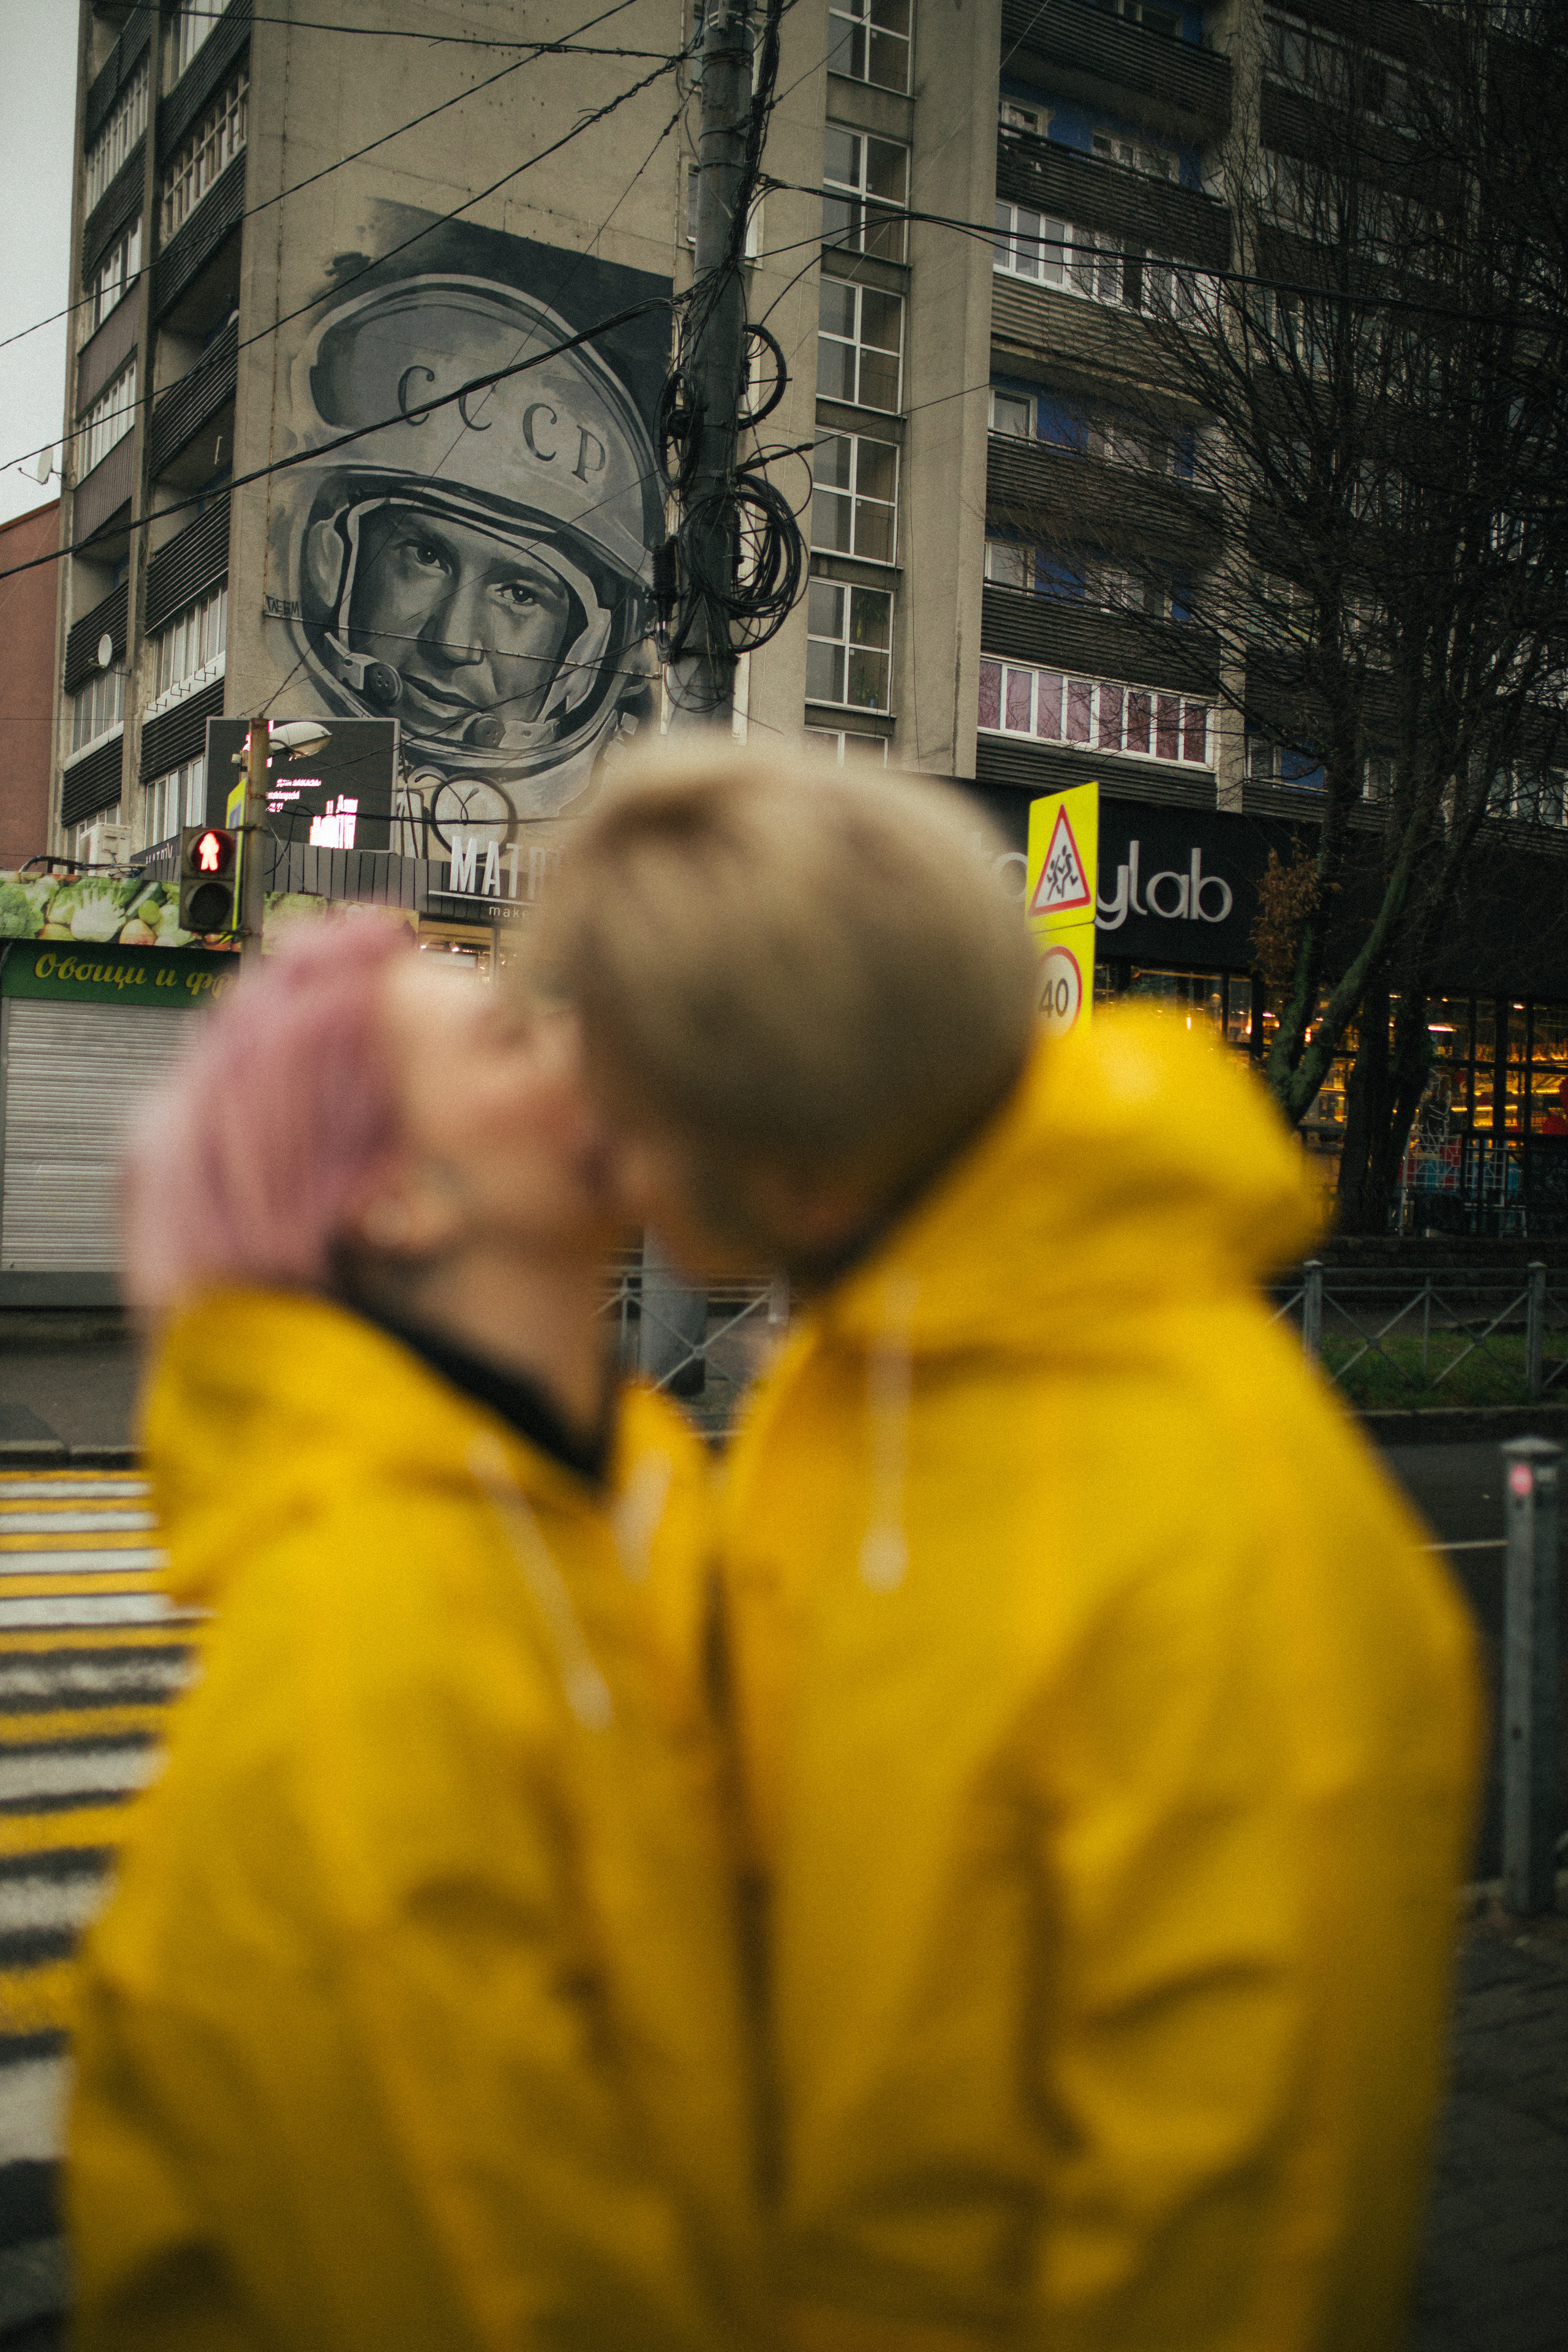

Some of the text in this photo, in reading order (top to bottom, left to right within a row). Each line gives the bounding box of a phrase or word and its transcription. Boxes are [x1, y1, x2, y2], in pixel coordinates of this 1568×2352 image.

[398, 364, 606, 484] СССР
[34, 952, 235, 999] Овощи и фр
[1039, 978, 1069, 1018] 40
